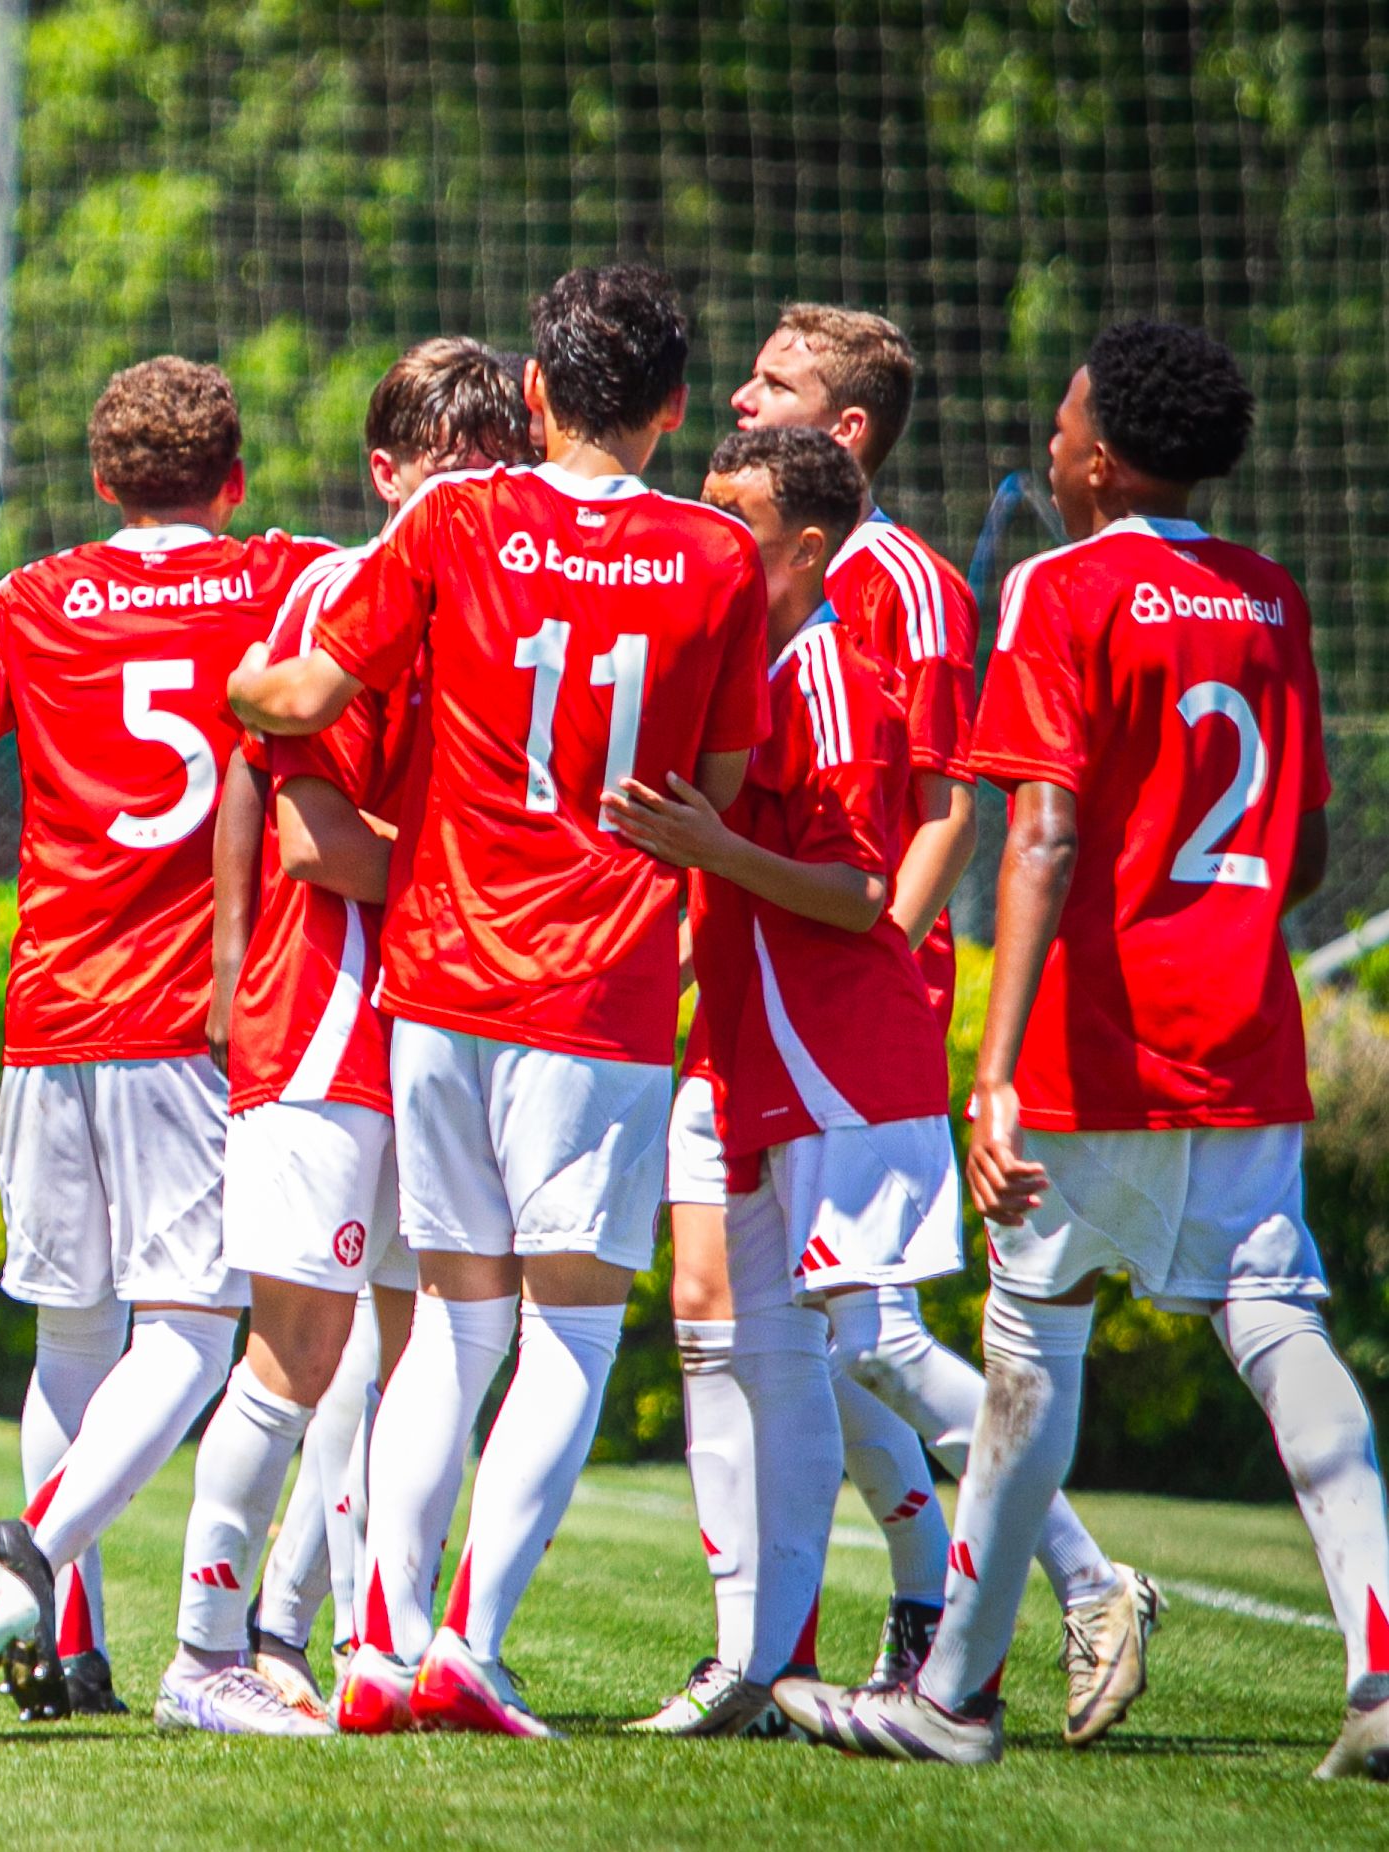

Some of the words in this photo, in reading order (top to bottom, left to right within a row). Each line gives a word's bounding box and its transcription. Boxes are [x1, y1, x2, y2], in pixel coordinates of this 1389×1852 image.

[108, 571, 253, 611] banrisul
[545, 539, 684, 585] banrisul
[1170, 586, 1285, 626] banrisul
[107, 659, 217, 848] 5
[514, 618, 649, 832] 11
[1170, 681, 1271, 890] 2
